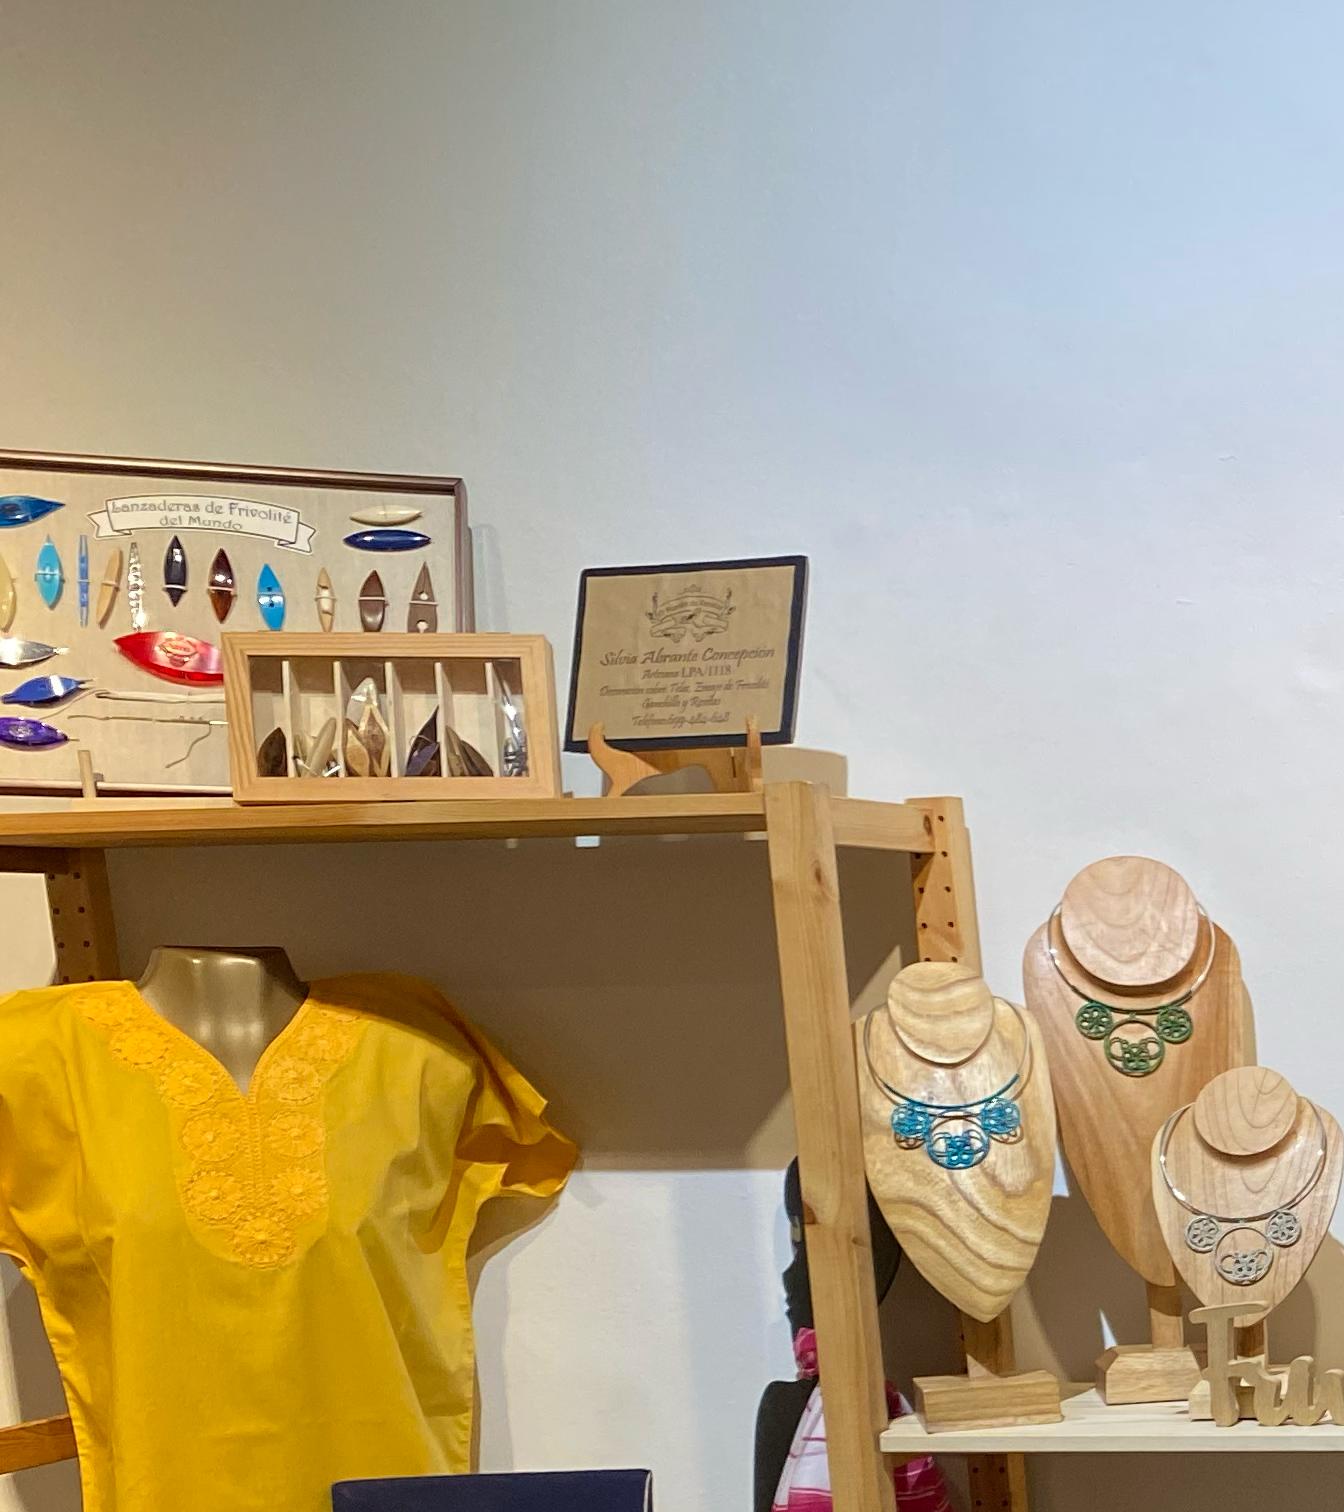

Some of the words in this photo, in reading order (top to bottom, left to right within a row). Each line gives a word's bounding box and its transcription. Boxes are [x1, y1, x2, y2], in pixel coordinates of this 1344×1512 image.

[111, 500, 200, 514] Lanzaderas
[205, 500, 224, 515] de
[228, 502, 293, 524] Frivolité
[159, 515, 183, 526] del
[188, 516, 243, 530] Mundo
[600, 649, 638, 666] Silvia
